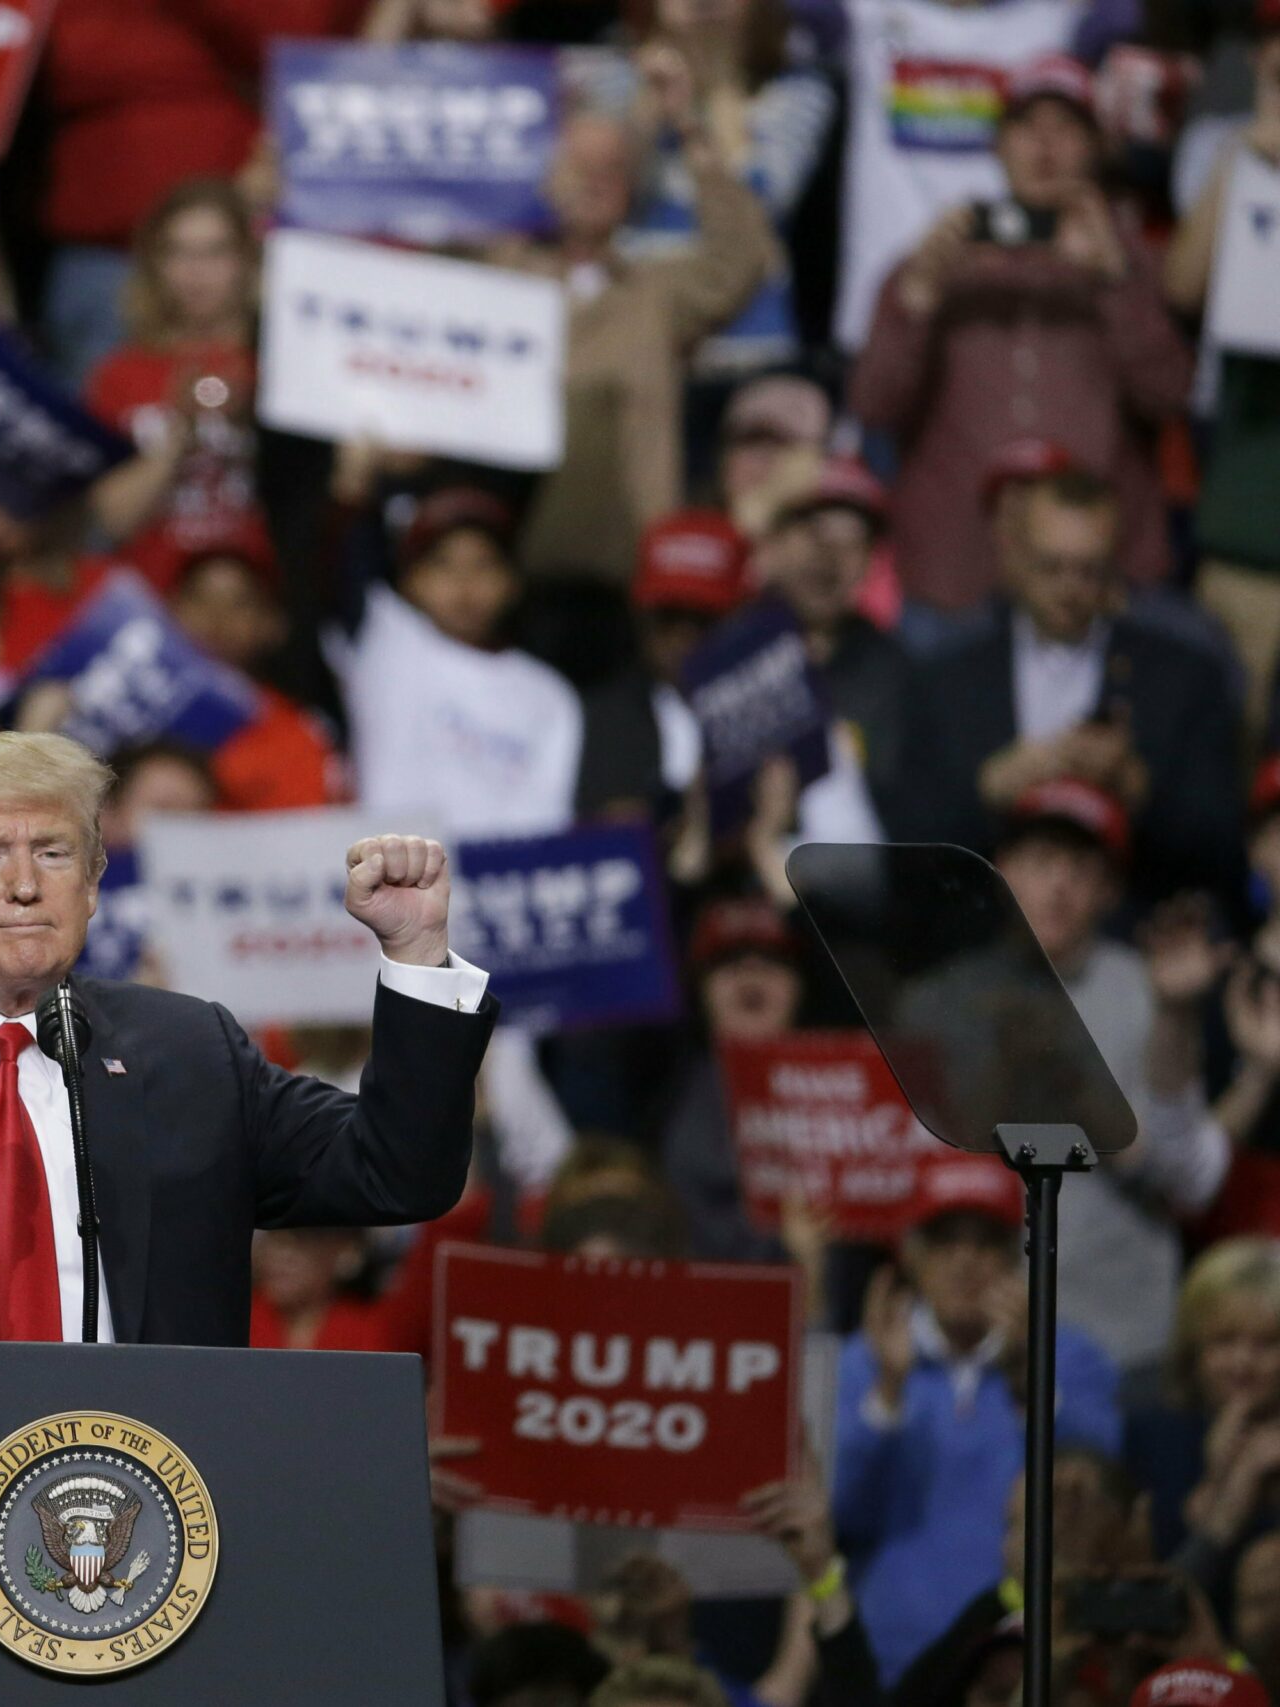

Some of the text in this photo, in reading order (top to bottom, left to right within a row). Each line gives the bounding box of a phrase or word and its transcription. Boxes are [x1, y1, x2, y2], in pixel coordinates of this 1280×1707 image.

[291, 84, 545, 131] TRUMP
[296, 292, 538, 362] TRUMP
[451, 1316, 781, 1393] TRUMP
[91, 1423, 114, 1439] OF
[119, 1428, 152, 1455] THE
[514, 1389, 709, 1453] 2020
[156, 1452, 210, 1560] UNITED
[109, 1583, 198, 1662] STATES
